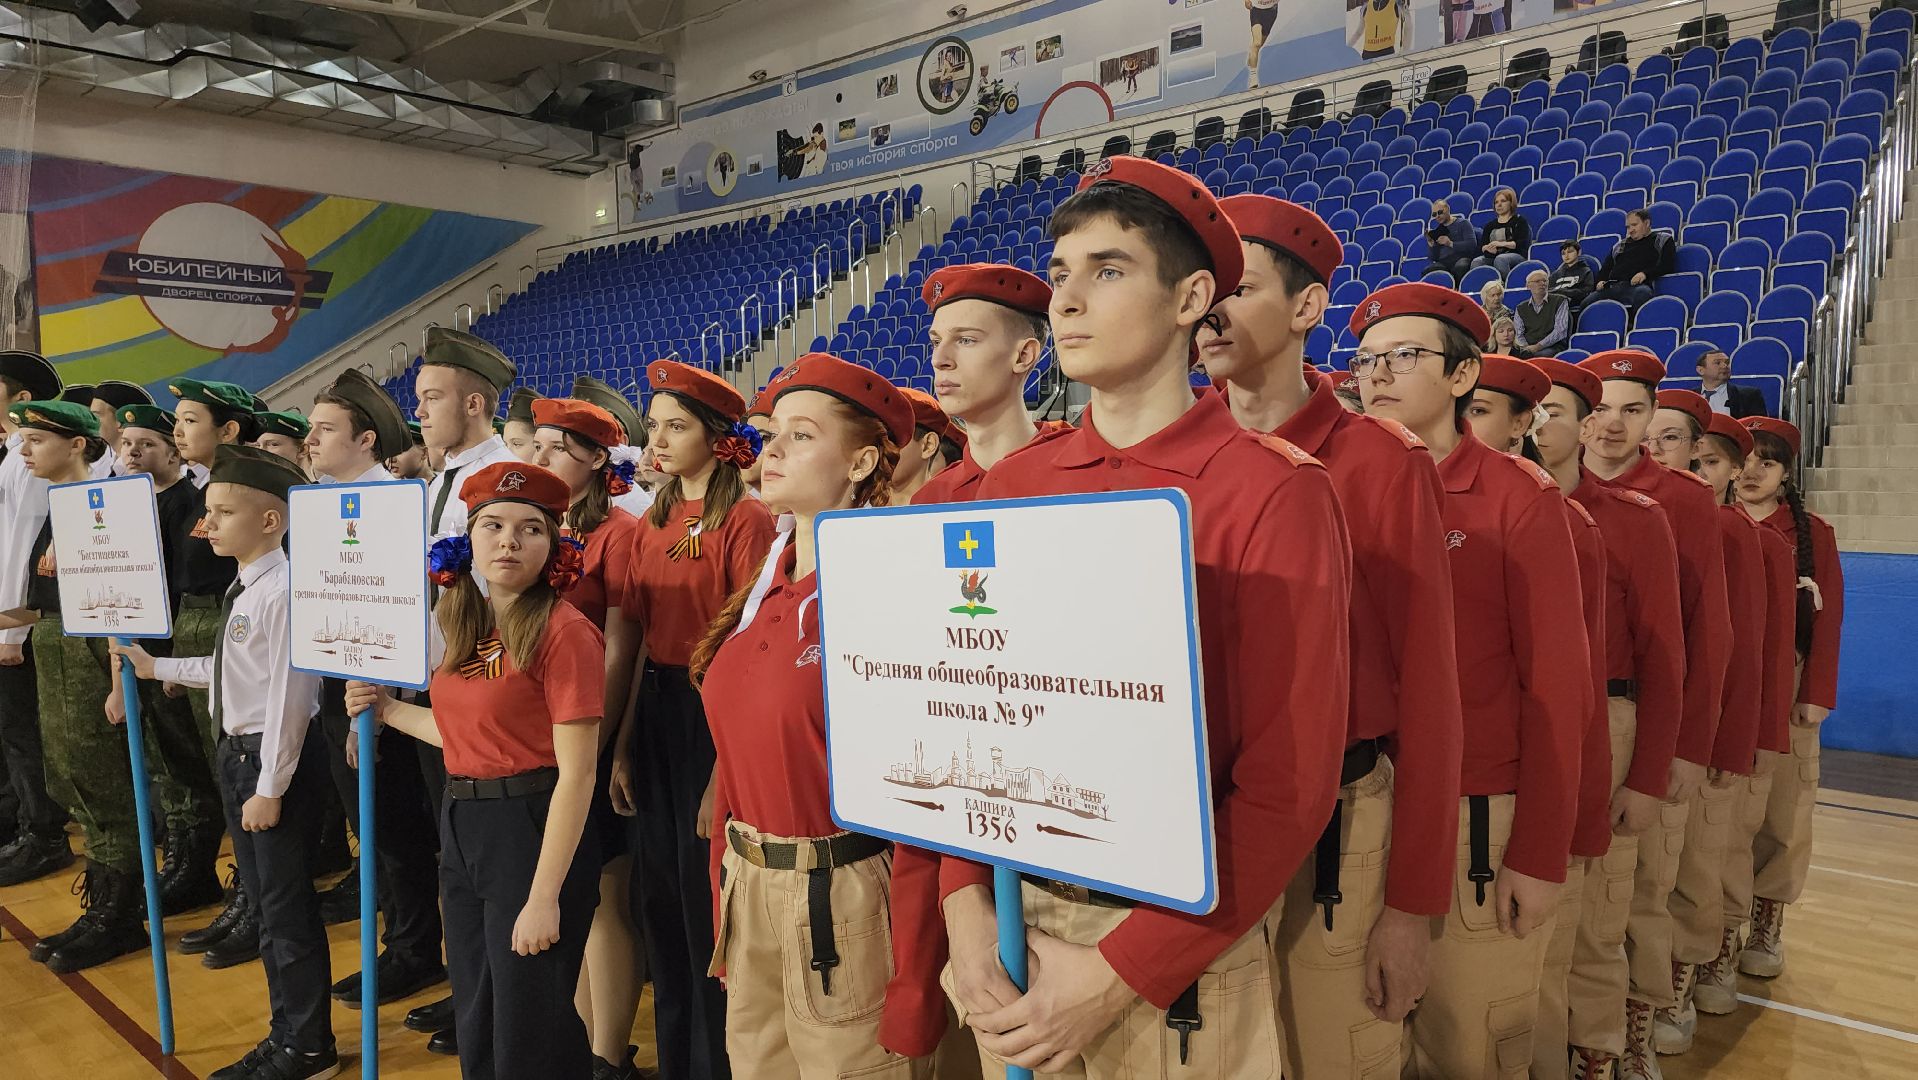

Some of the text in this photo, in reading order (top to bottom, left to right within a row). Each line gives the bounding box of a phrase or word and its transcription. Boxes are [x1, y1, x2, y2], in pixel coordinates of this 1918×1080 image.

[856, 147, 906, 167] история
[909, 135, 958, 155] спорта
[128, 257, 283, 284] ЮБИЛЕЙНЫЙ
[161, 287, 263, 303] ДВОРЕЦ СПОРТА
[339, 551, 364, 564] МБОУ
[945, 626, 1009, 653] МБОУ
[343, 653, 364, 668] 1356
[843, 653, 1165, 703] "Средняя общеобразовательная
[926, 700, 1045, 728] школа № 9"
[964, 797, 1016, 819] КАШИРА
[965, 811, 1018, 844] 1356
